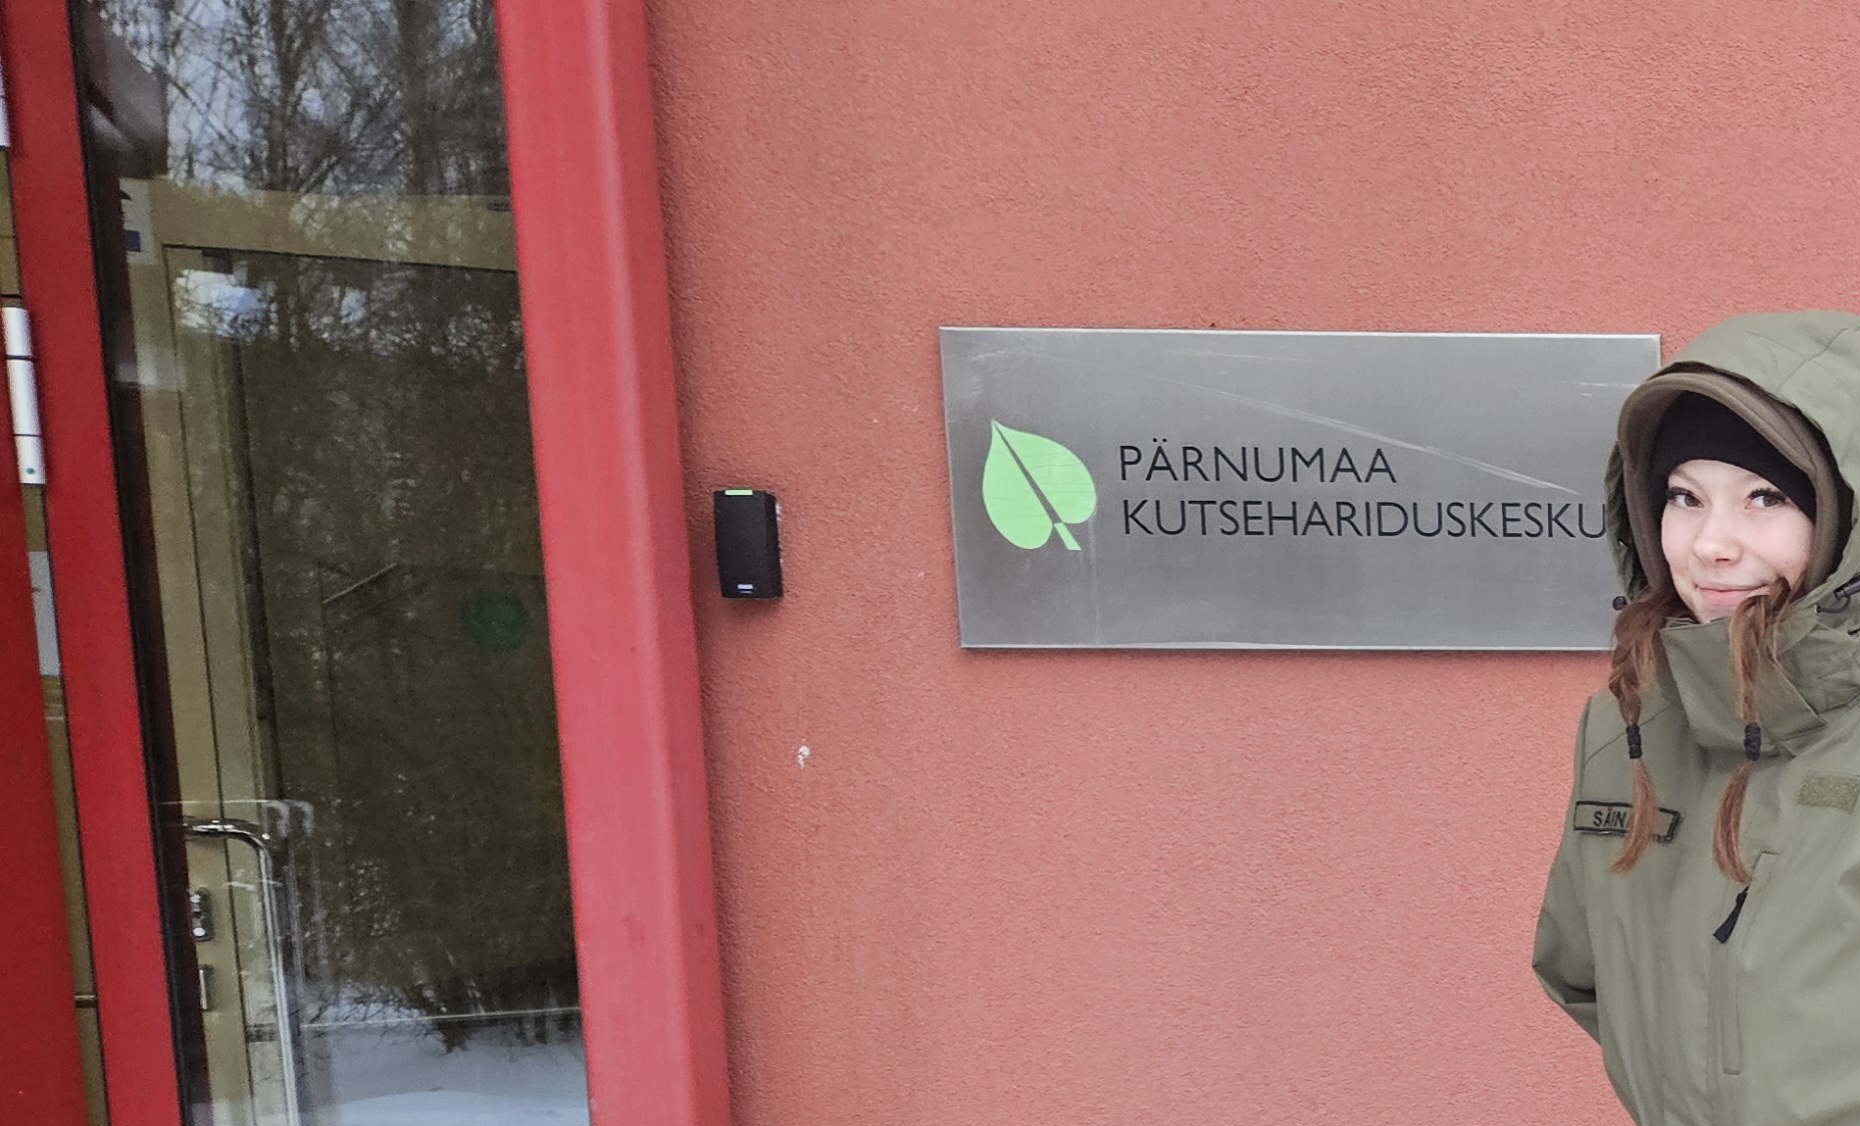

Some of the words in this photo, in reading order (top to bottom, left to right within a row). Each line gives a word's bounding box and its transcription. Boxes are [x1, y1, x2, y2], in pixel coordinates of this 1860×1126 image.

[1118, 437, 1398, 484] PÄRNUMAA
[1122, 499, 1607, 539] KUTSEHARIDUSKESKU
[1593, 808, 1633, 829] SÄIN
